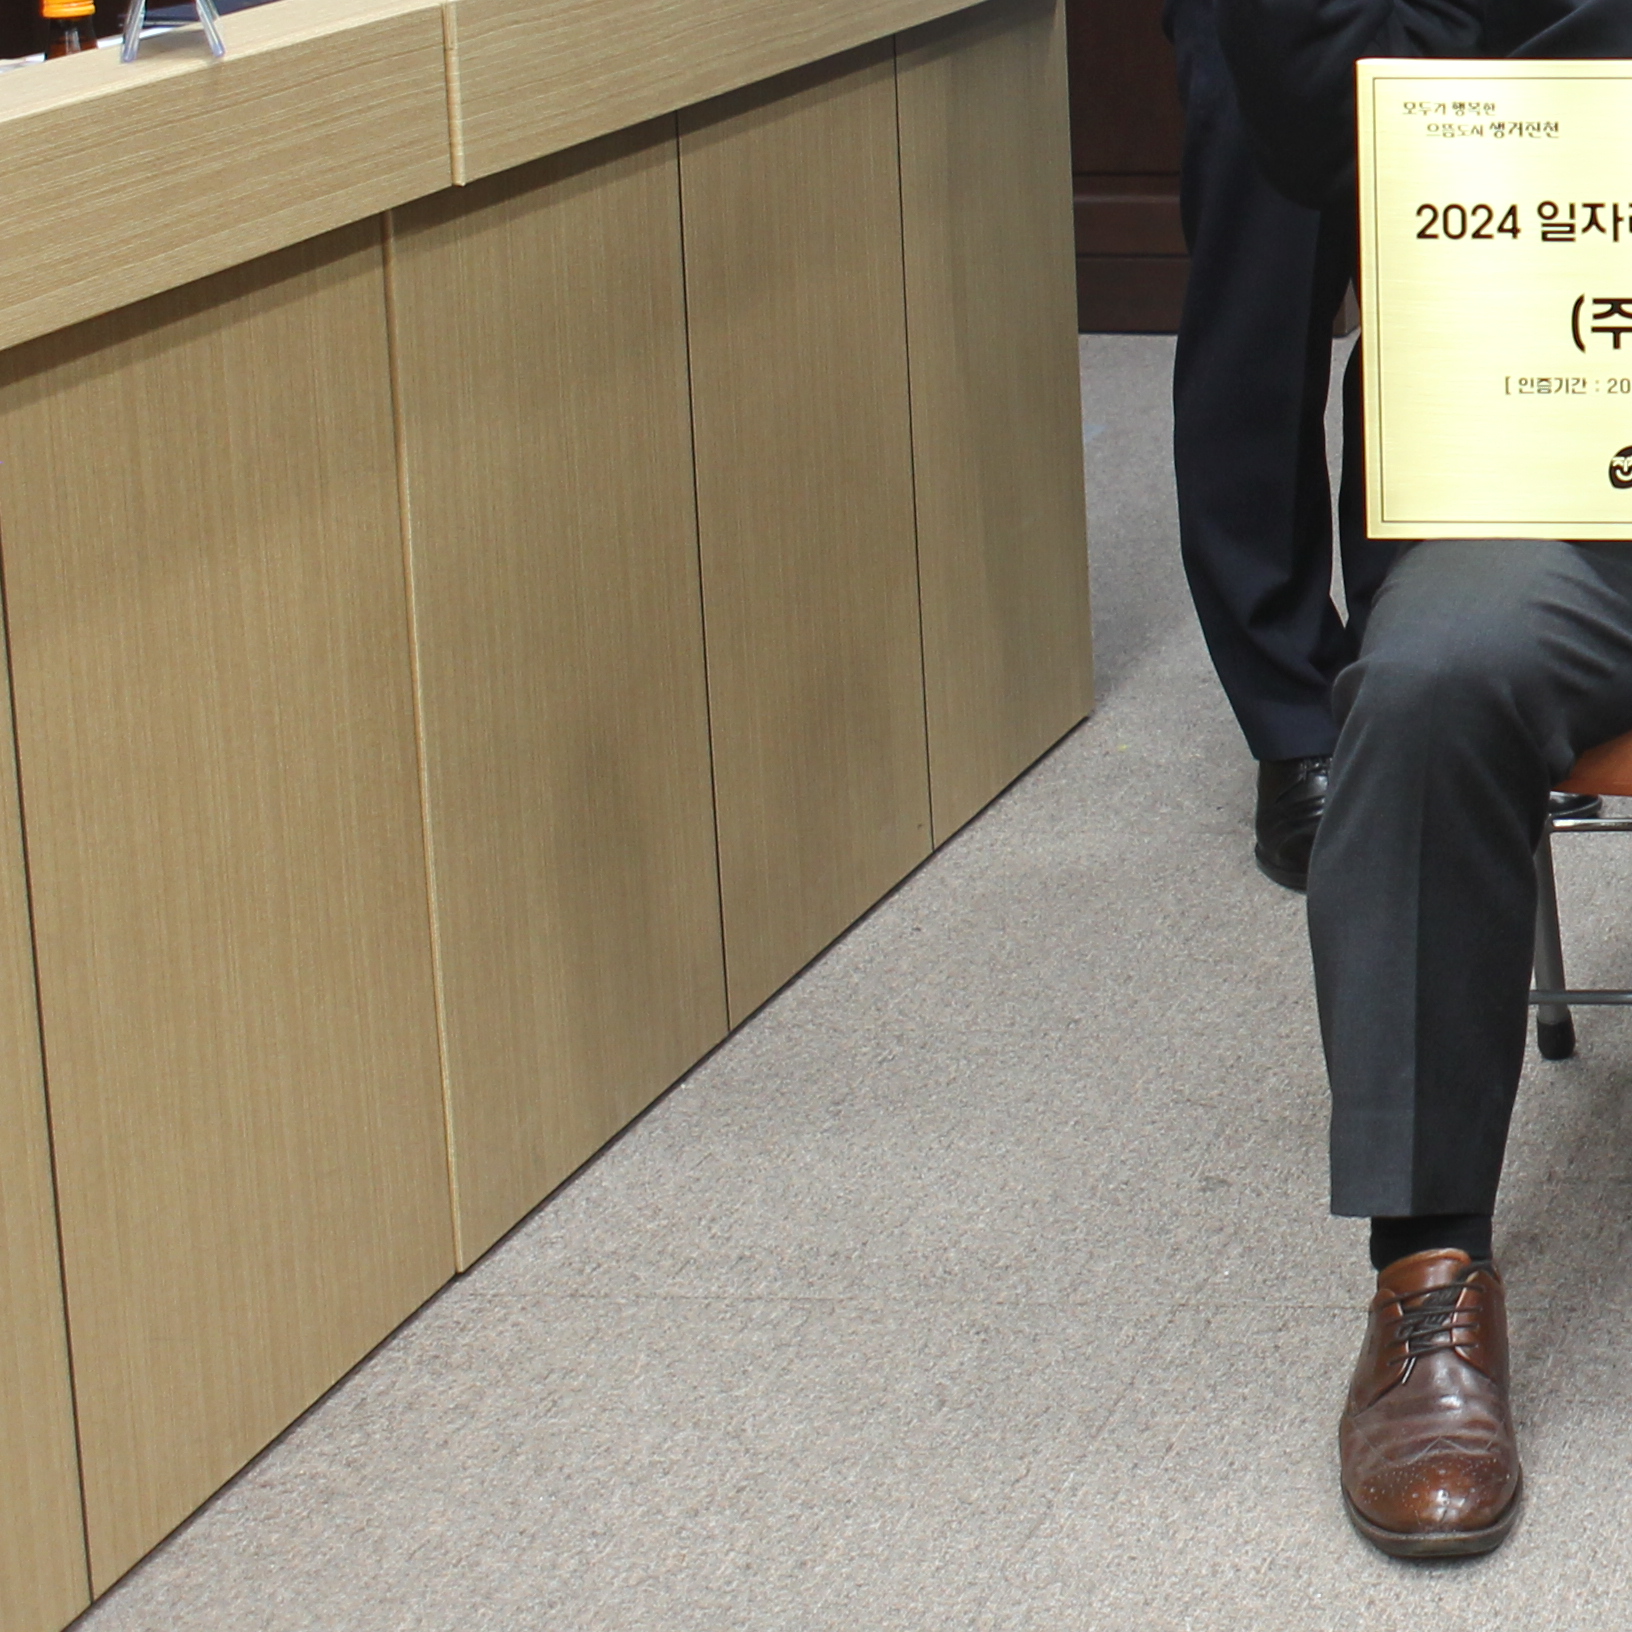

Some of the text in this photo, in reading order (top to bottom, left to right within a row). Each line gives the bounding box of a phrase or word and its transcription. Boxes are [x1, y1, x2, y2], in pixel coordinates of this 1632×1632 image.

[1403, 101, 1496, 117] 모두가 행복한
[1427, 121, 1559, 139] 으뜸도시 생거진천
[1415, 204, 1521, 241] 2024
[1518, 377, 1588, 395] 인증기간
